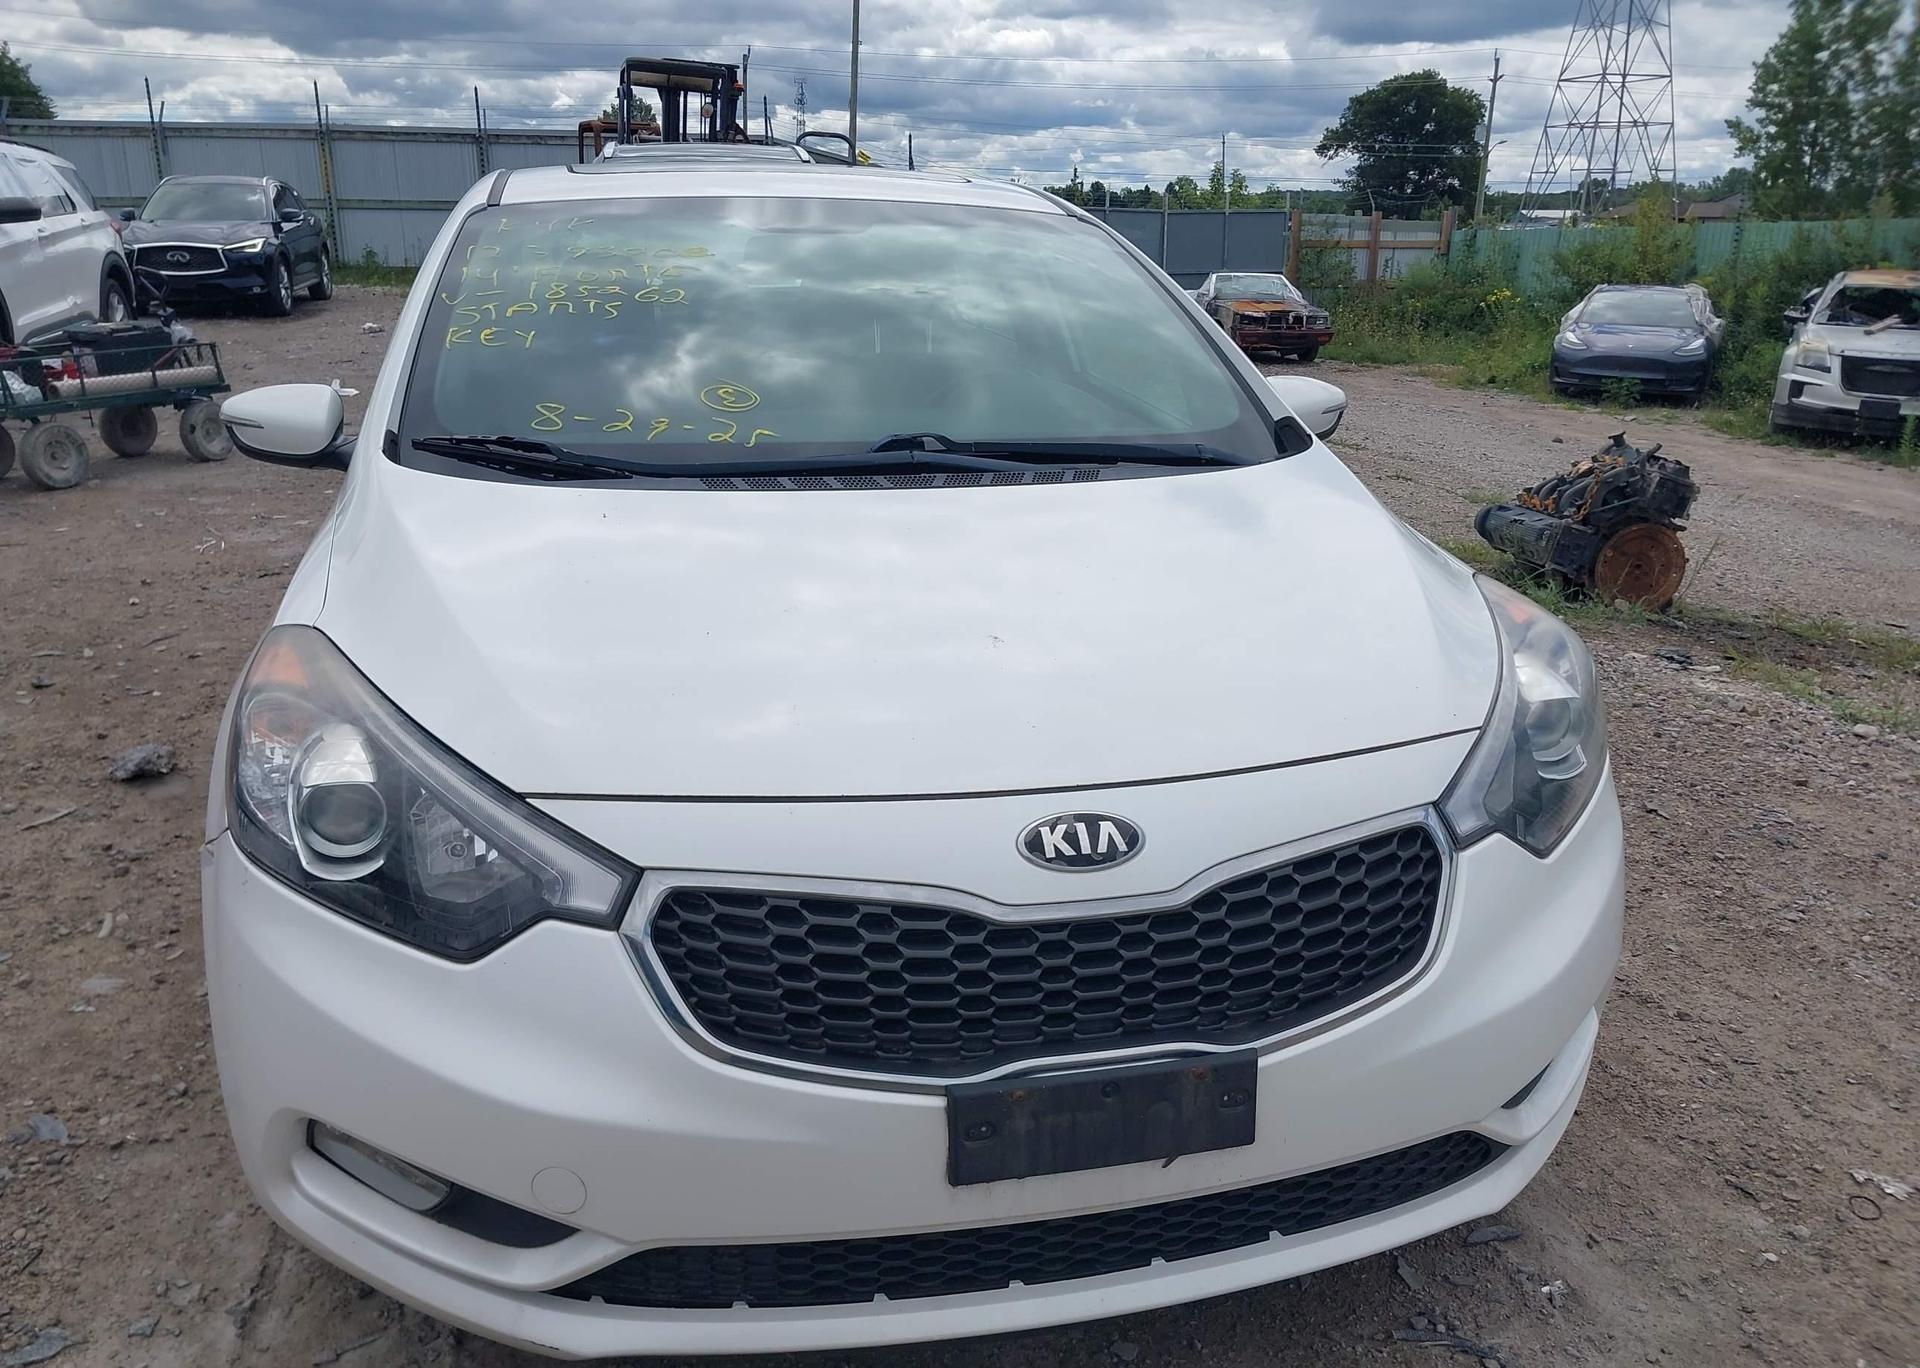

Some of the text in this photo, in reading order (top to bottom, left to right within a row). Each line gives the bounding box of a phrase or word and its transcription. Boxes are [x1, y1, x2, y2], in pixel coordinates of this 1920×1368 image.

[455, 299, 623, 326] STARTS
[446, 327, 537, 350] KEY
[1038, 820, 1129, 859] KIA
